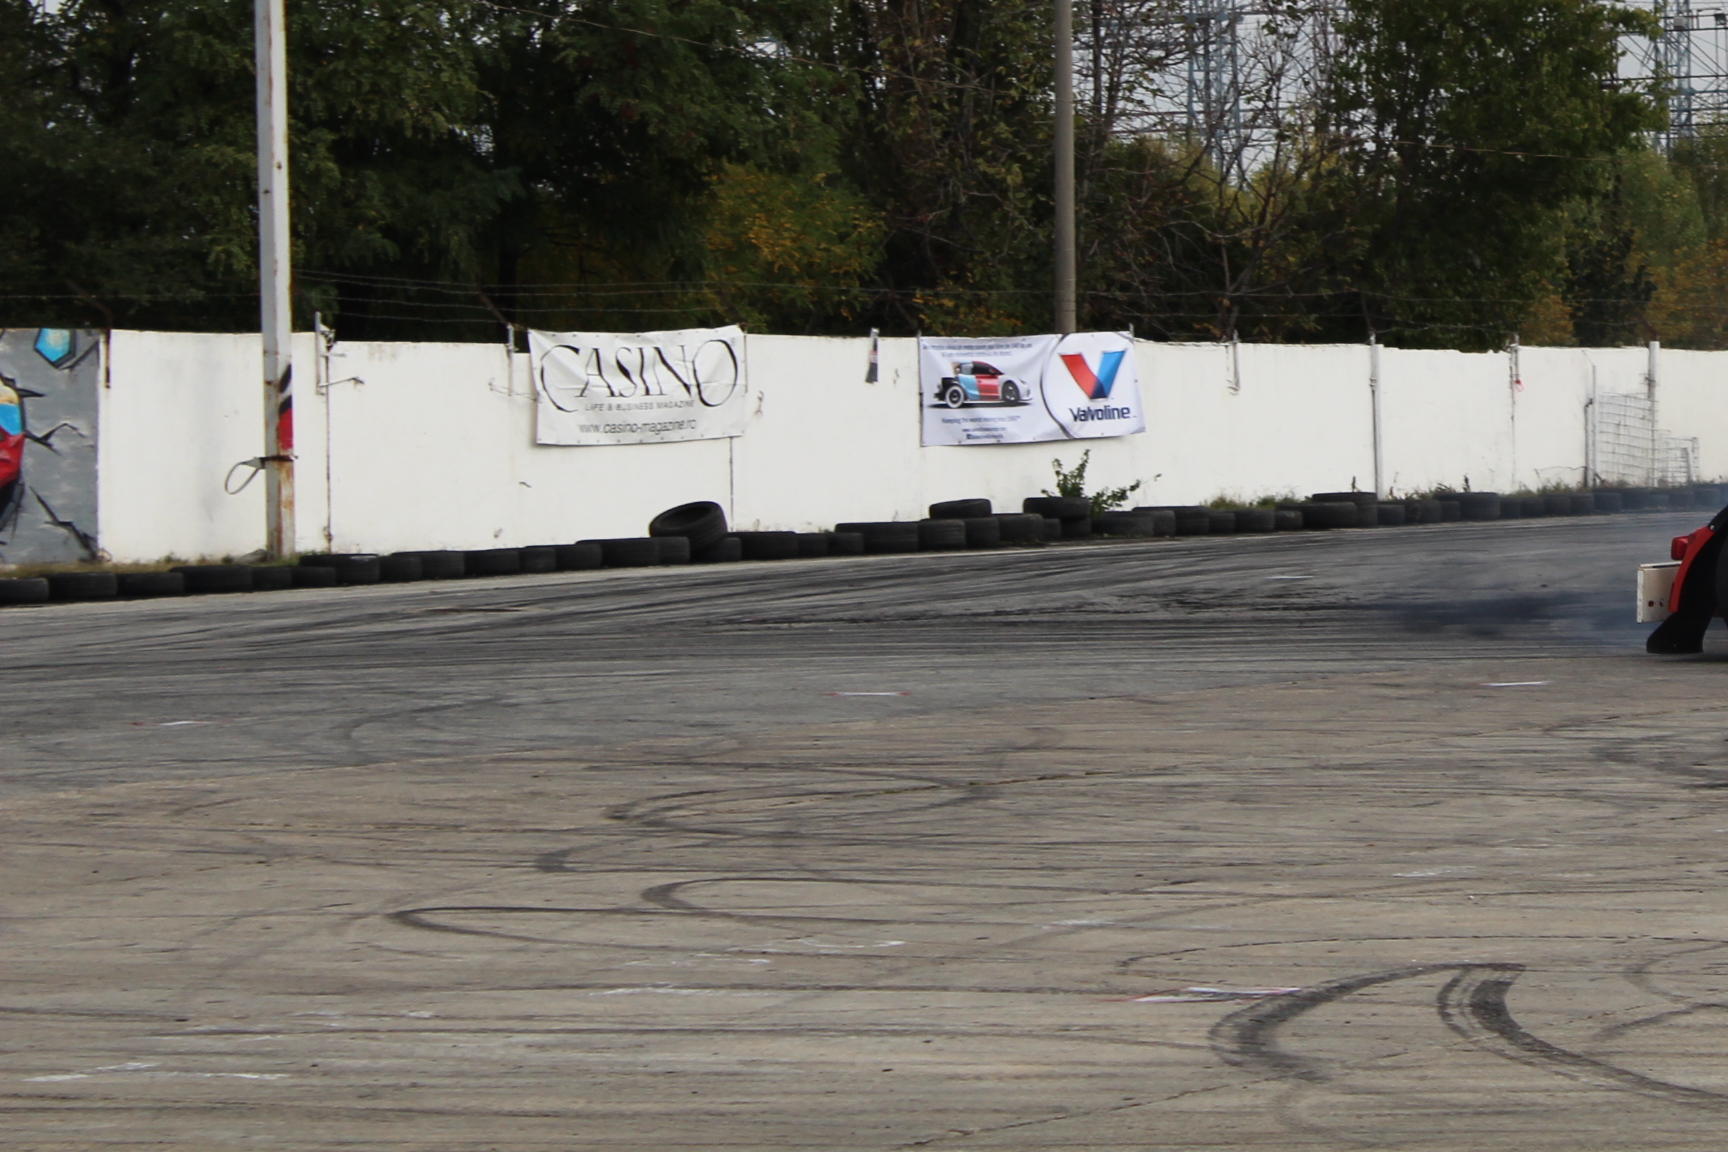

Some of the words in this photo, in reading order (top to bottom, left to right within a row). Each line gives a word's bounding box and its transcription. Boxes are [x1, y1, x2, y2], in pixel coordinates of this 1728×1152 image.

[540, 339, 738, 413] CASINO
[585, 403, 604, 411] LIFE
[616, 402, 654, 411] BUSINESS
[657, 400, 695, 409] MAGAZINE
[1069, 405, 1131, 422] Valvoline
[578, 419, 697, 435] www.casino-magazine.ro
